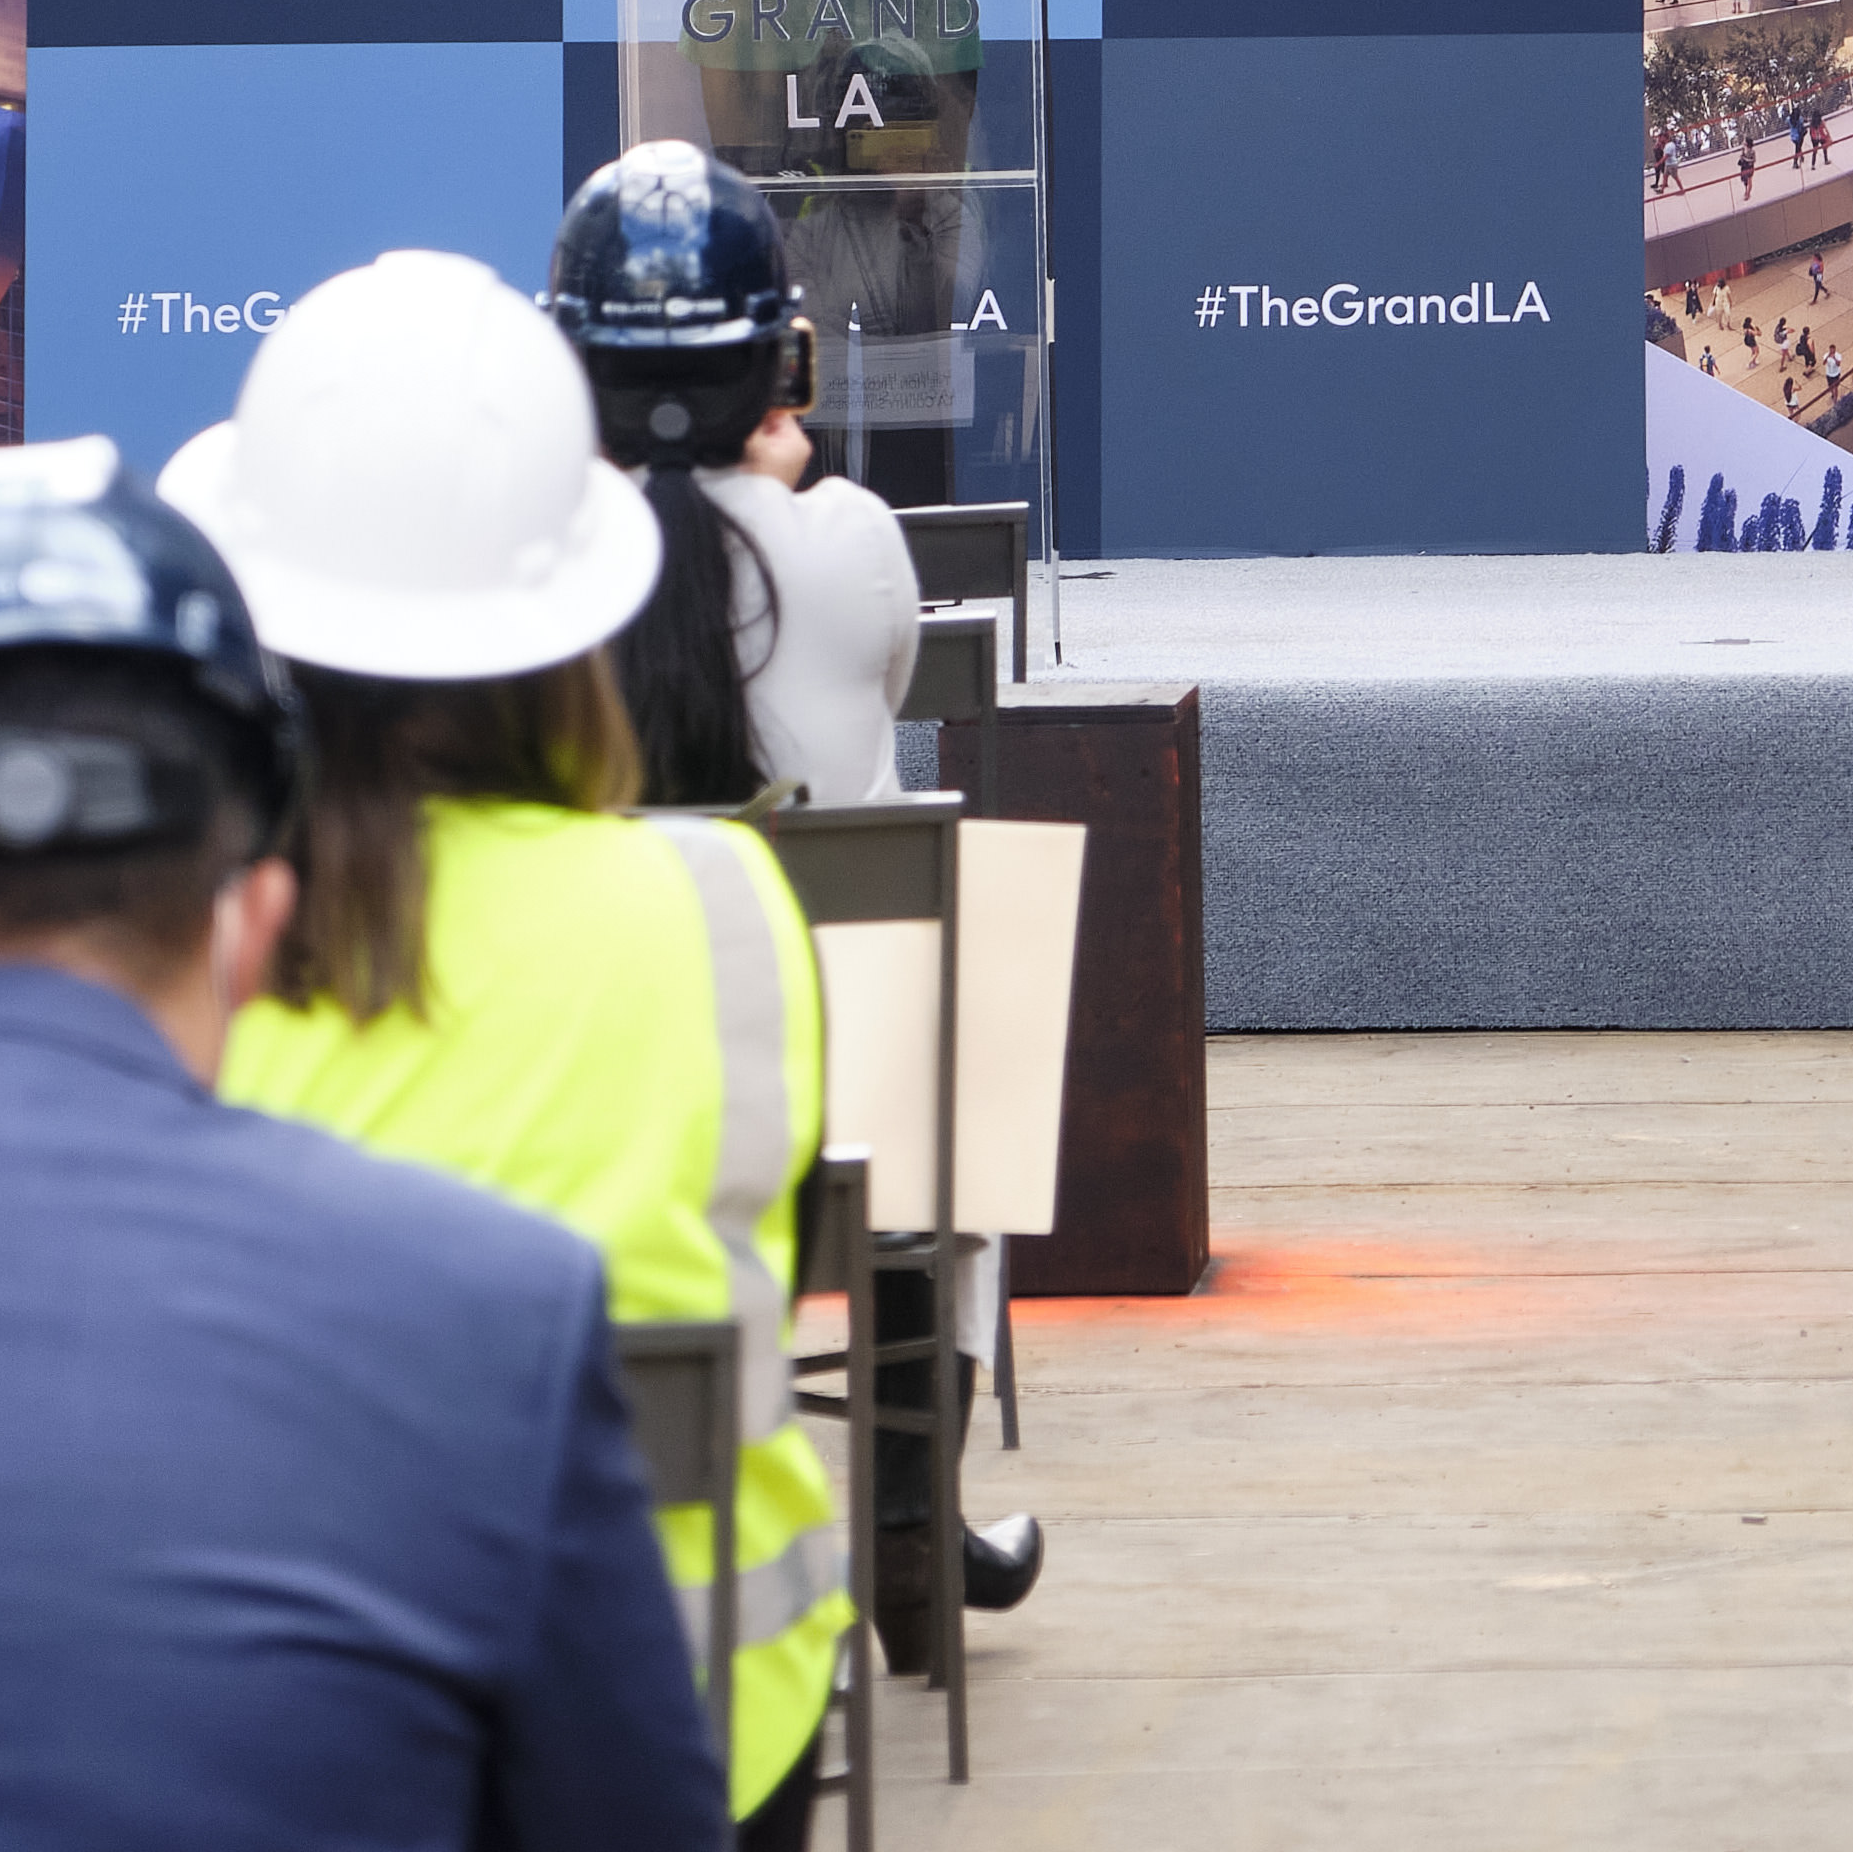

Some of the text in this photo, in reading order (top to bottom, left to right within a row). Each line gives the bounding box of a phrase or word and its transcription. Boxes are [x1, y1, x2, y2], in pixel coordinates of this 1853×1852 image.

[785, 73, 885, 130] LA
[117, 291, 294, 334] #TheG
[1195, 282, 1551, 328] #TheGrandLA
